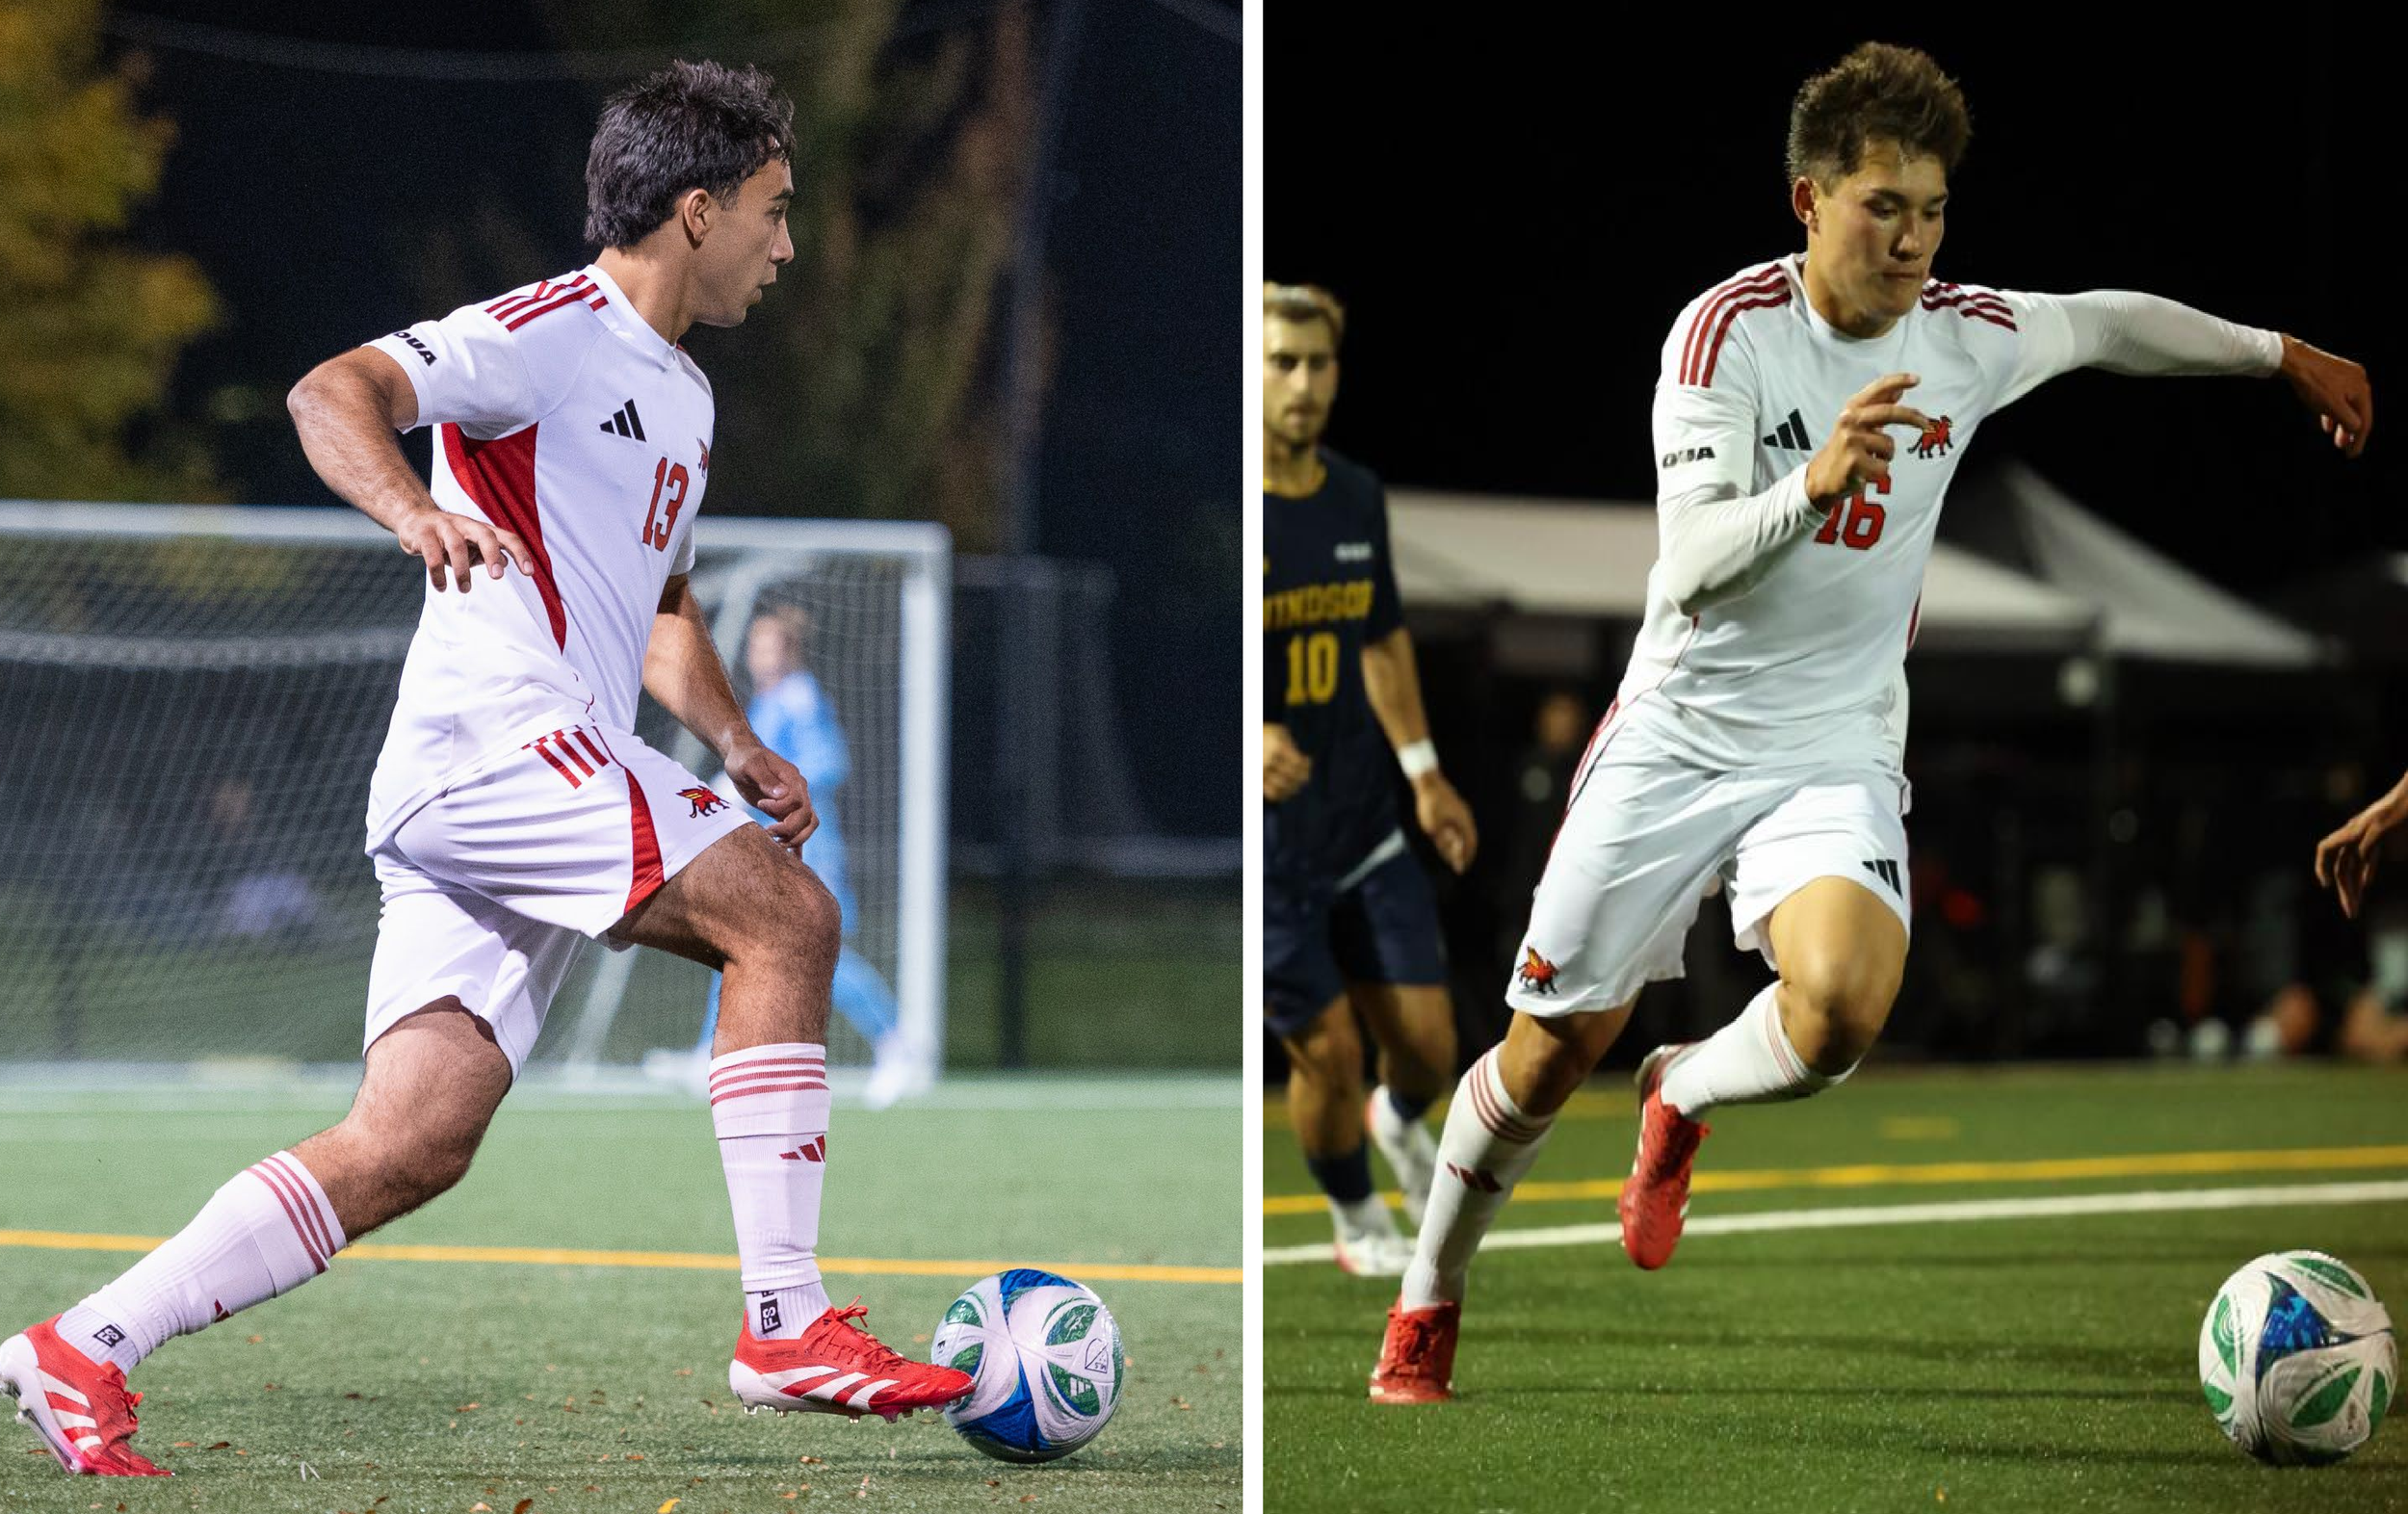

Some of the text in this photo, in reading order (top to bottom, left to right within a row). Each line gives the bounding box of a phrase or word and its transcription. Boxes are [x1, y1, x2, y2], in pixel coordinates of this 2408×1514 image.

[393, 331, 438, 367] OUA
[642, 456, 690, 552] 13
[1814, 473, 1892, 550] 16
[1286, 633, 1339, 706] 10
[763, 1306, 779, 1331] FS
